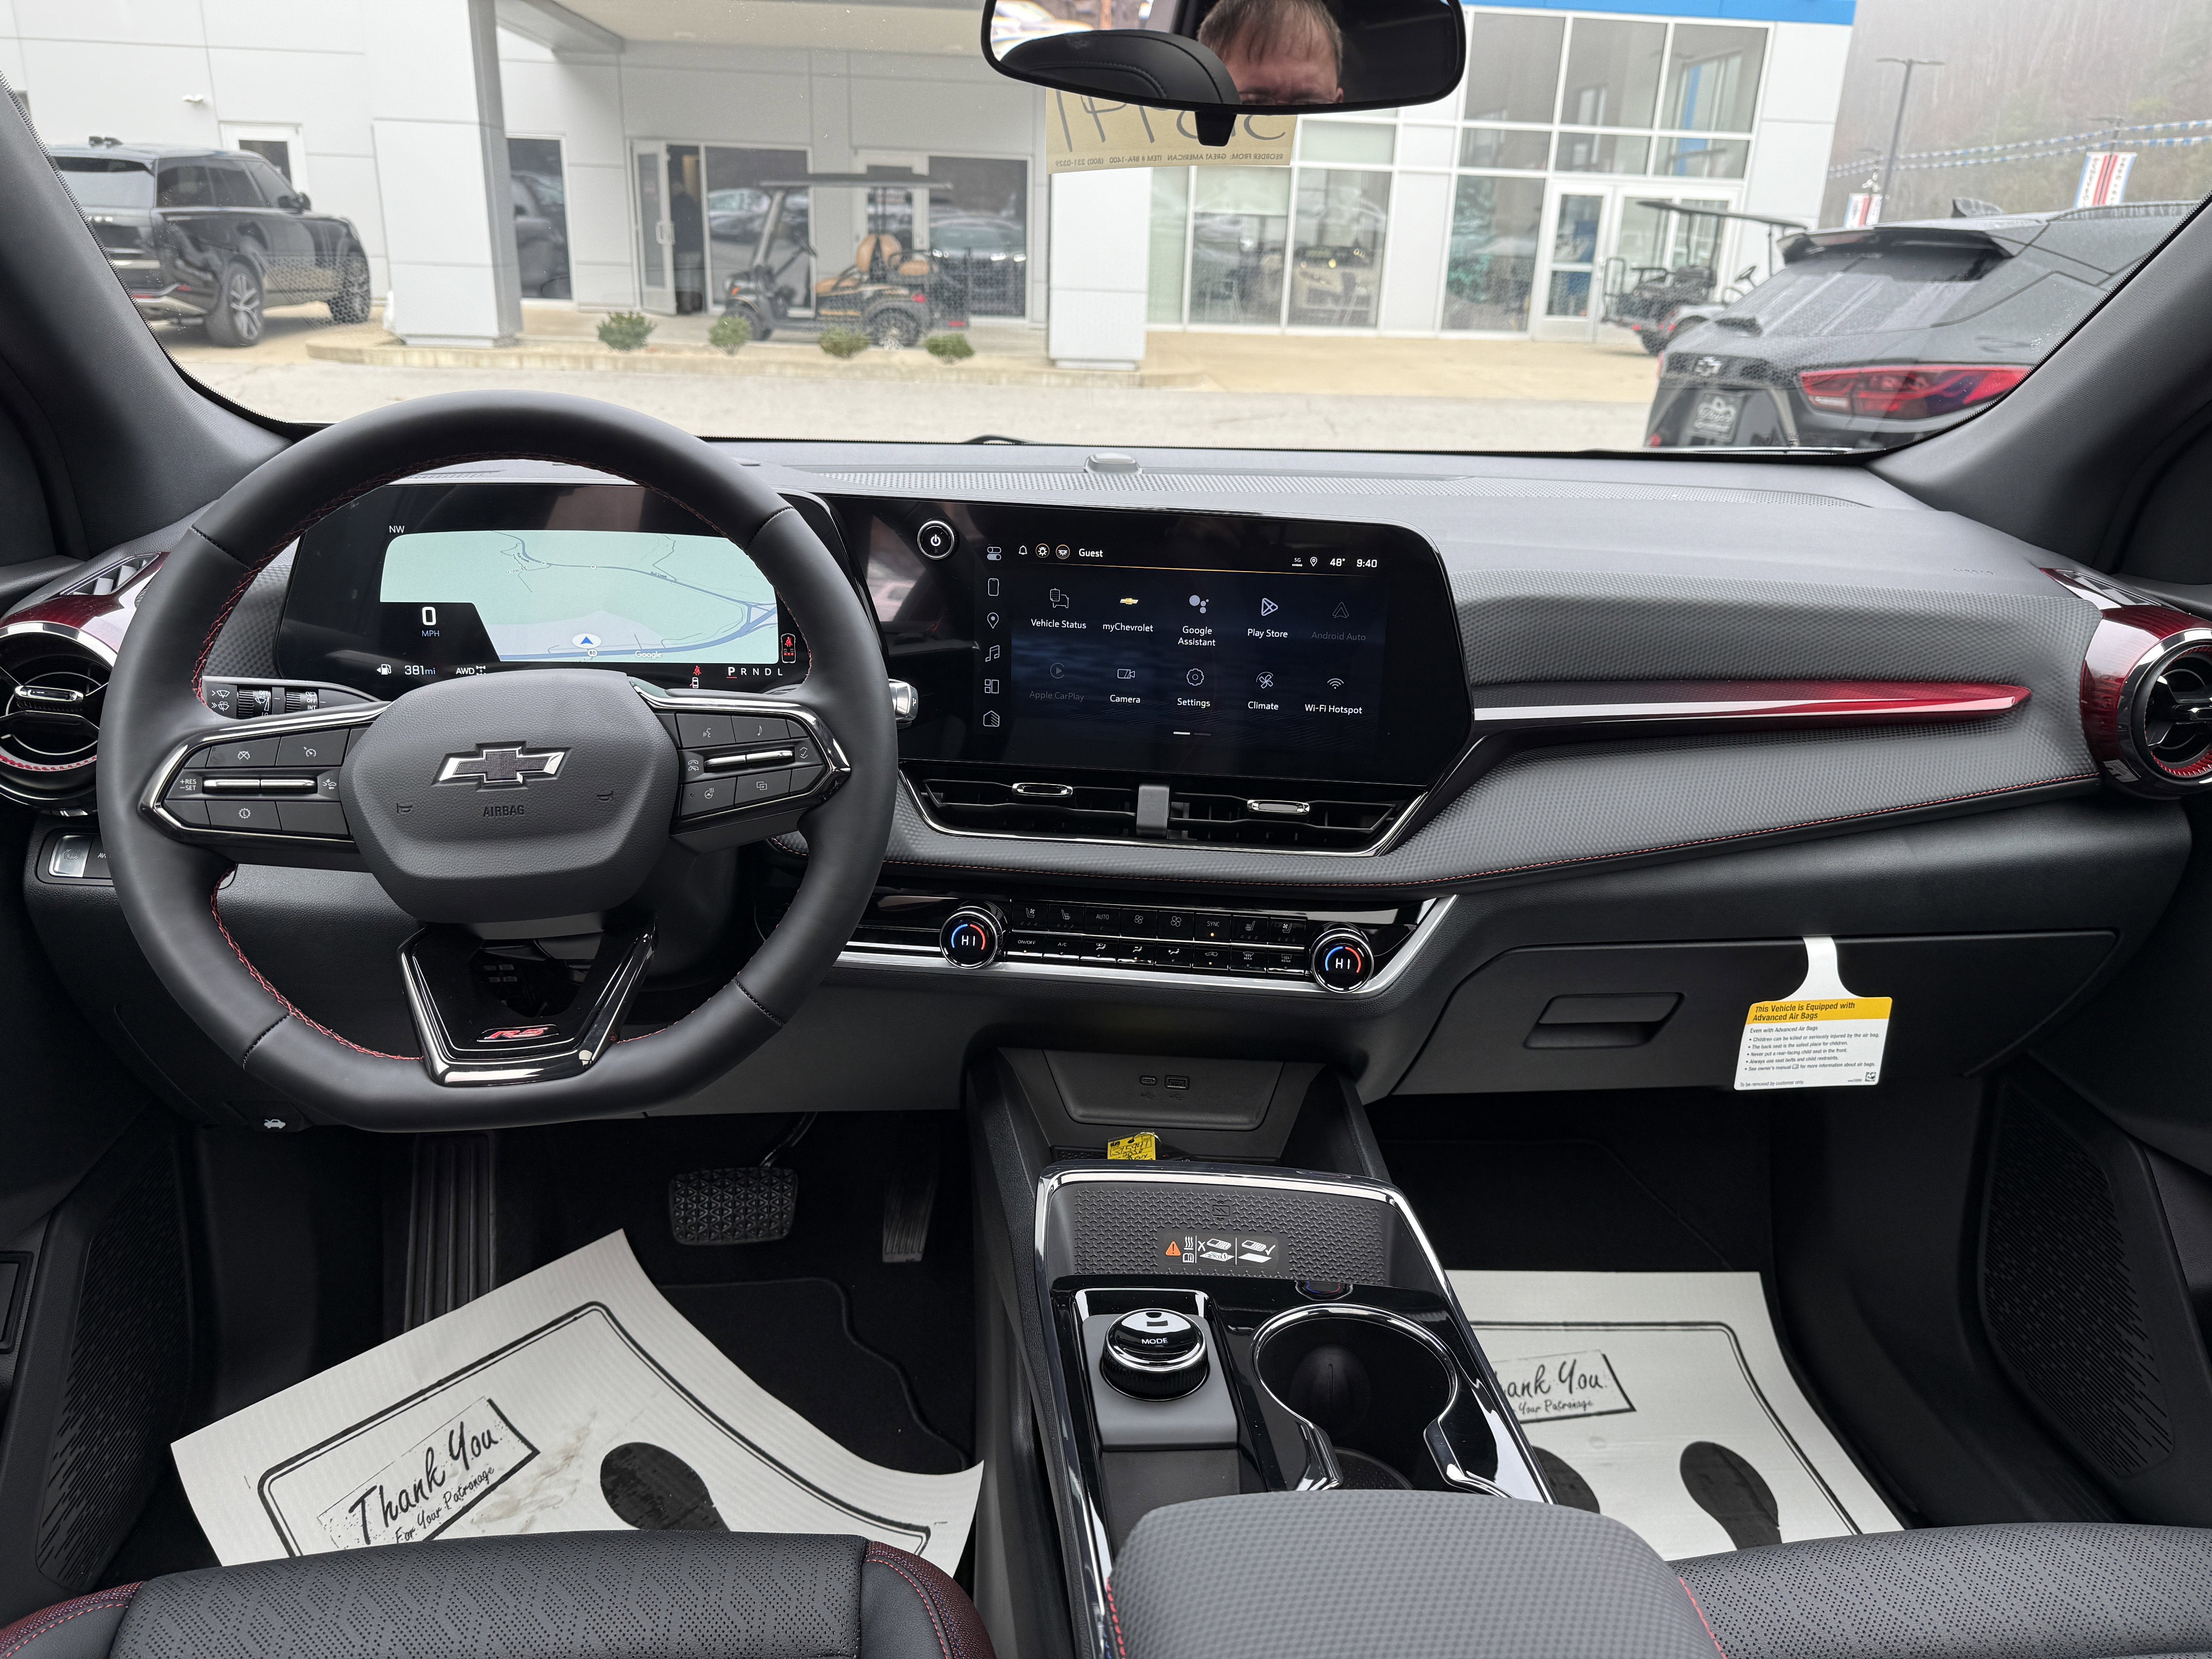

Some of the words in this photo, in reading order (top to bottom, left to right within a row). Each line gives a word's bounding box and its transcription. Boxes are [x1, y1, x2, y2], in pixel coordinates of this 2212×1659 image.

[389, 525, 405, 534] NW
[1079, 548, 1103, 558] Guest
[1356, 559, 1377, 568] 9:40
[422, 606, 436, 626] 0
[1031, 618, 1060, 628] Vehicle
[1061, 620, 1087, 629] Status
[1103, 622, 1154, 632] myChevrolet
[1182, 625, 1212, 636] Google
[1247, 628, 1264, 639] Play
[1266, 629, 1288, 638] Store
[1178, 637, 1216, 647] Assistant
[1311, 632, 1344, 640] Android
[1346, 633, 1366, 641] Auto
[635, 650, 663, 660] Google
[728, 666, 735, 676] P
[752, 668, 759, 676] N
[764, 668, 772, 676] D
[1029, 690, 1053, 700] Apple
[1055, 692, 1084, 702] CarPlay
[1109, 694, 1141, 704] Camera
[1177, 697, 1211, 708] Settings
[1248, 701, 1279, 710] Climate
[1305, 704, 1326, 712] Wi-Fi
[1329, 705, 1362, 715] Hotspot
[483, 804, 525, 818] AIRBAG
[962, 935, 975, 946] HI
[1335, 958, 1350, 970] HI
[1755, 1005, 1769, 1013] This
[1771, 1004, 1796, 1012] Vehicle
[1806, 1002, 1838, 1012] Equipped
[1753, 1013, 1788, 1021] Advanced
[484, 1027, 550, 1039] RS
[1495, 1364, 1551, 1398] ank
[1558, 1358, 1603, 1394] You
[1518, 1402, 1541, 1415] Your
[1544, 1398, 1594, 1413] Patronage
[349, 1446, 446, 1545] Thank
[448, 1420, 499, 1471] You
[395, 1525, 417, 1544] For
[417, 1506, 442, 1529] Your
[443, 1465, 495, 1510] Patronage
